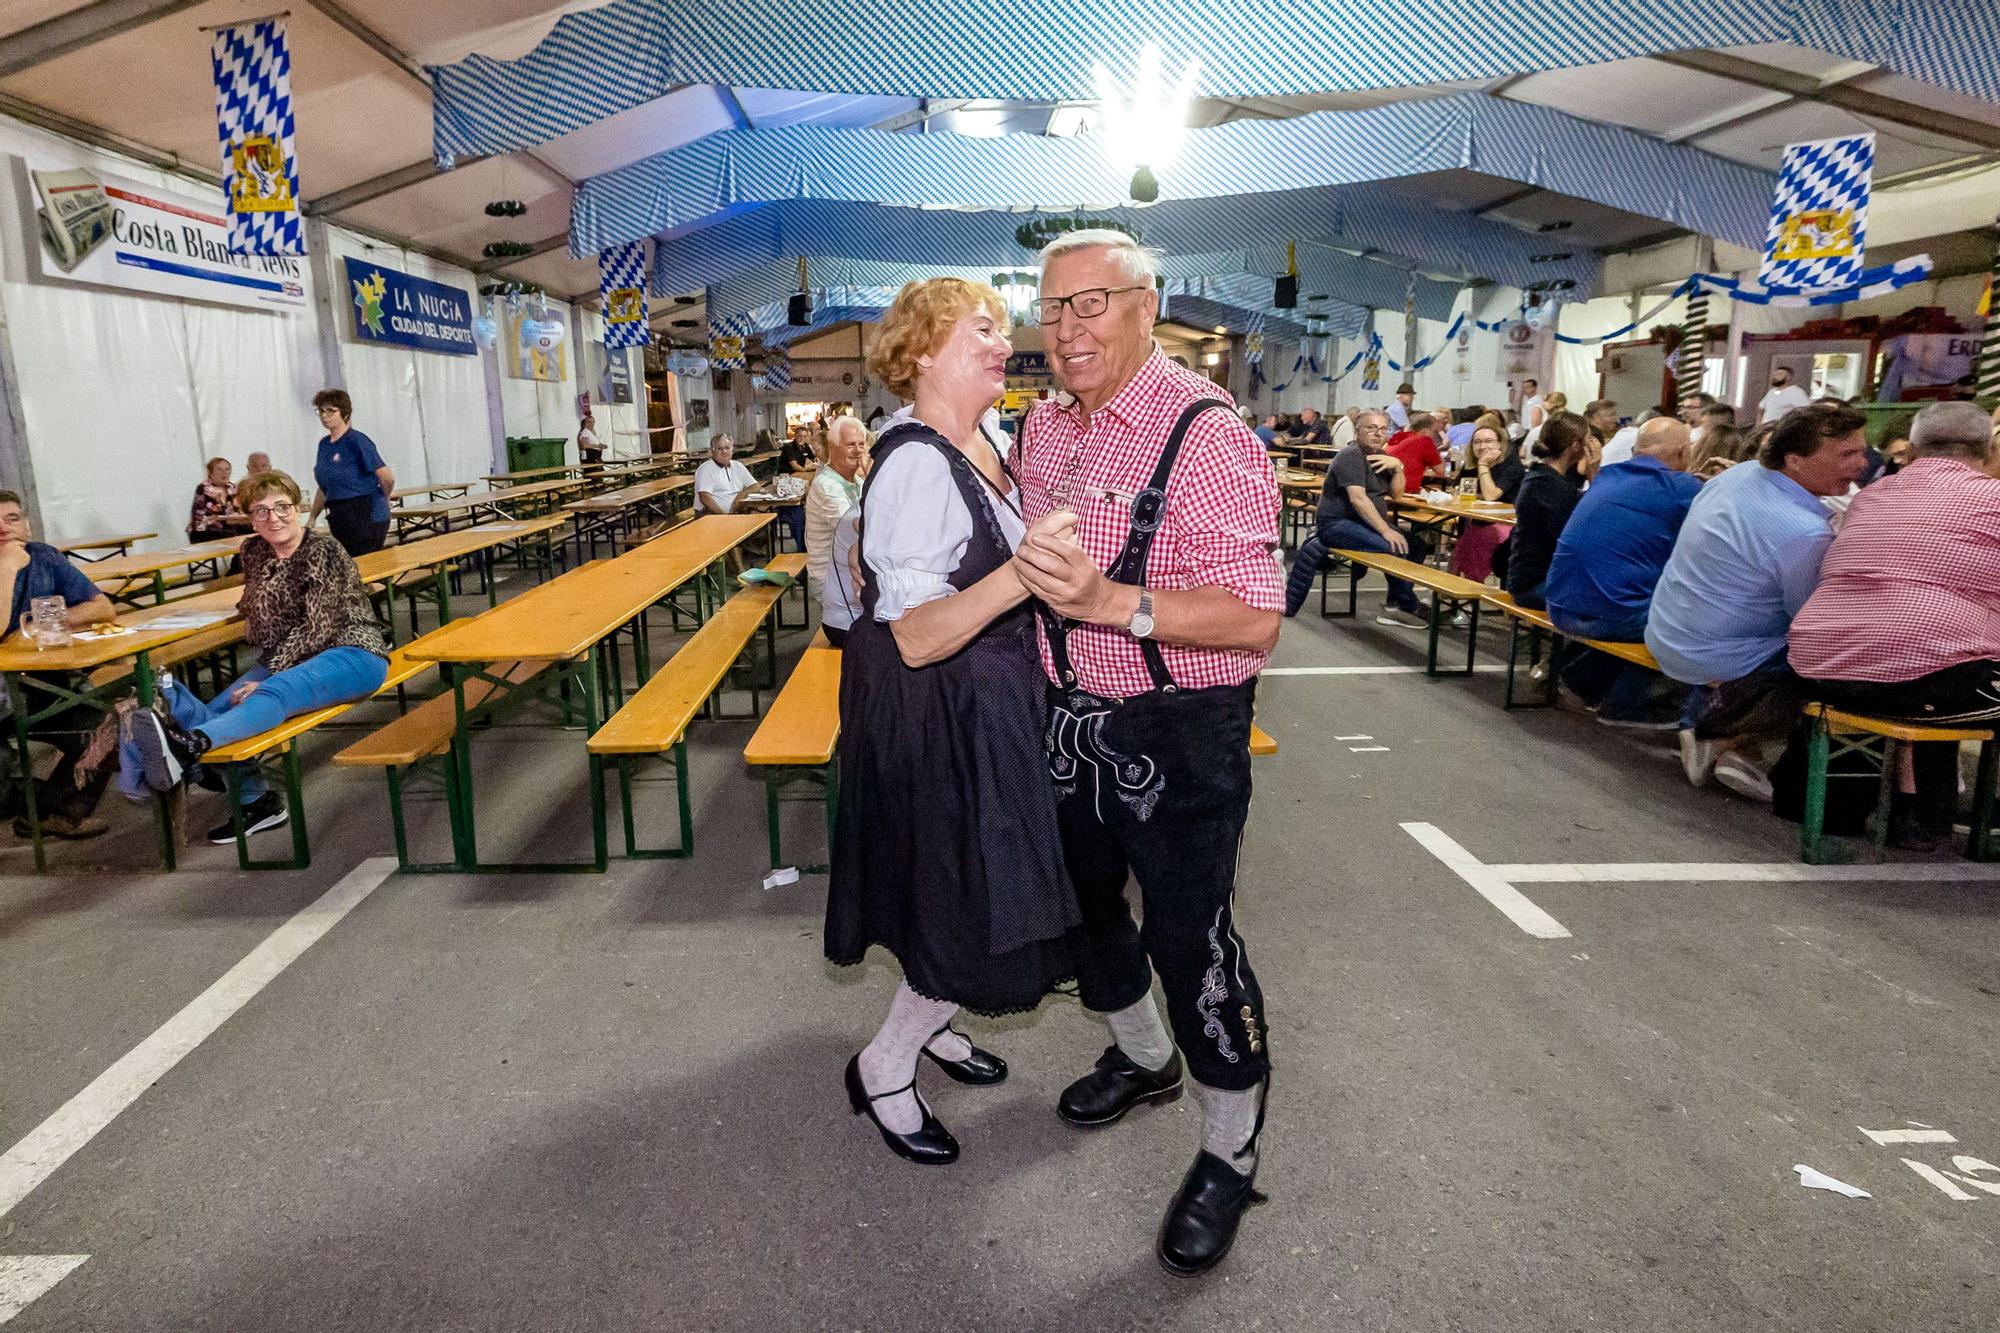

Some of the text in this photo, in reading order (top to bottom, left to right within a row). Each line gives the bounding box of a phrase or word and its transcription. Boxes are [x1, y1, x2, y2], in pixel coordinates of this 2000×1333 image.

[112, 208, 178, 254] Costa
[393, 287, 413, 313] LA
[391, 315, 473, 344] CIUDAD DEL DEPORTE
[1947, 338, 1984, 356] ERD
[790, 376, 813, 384] INGER
